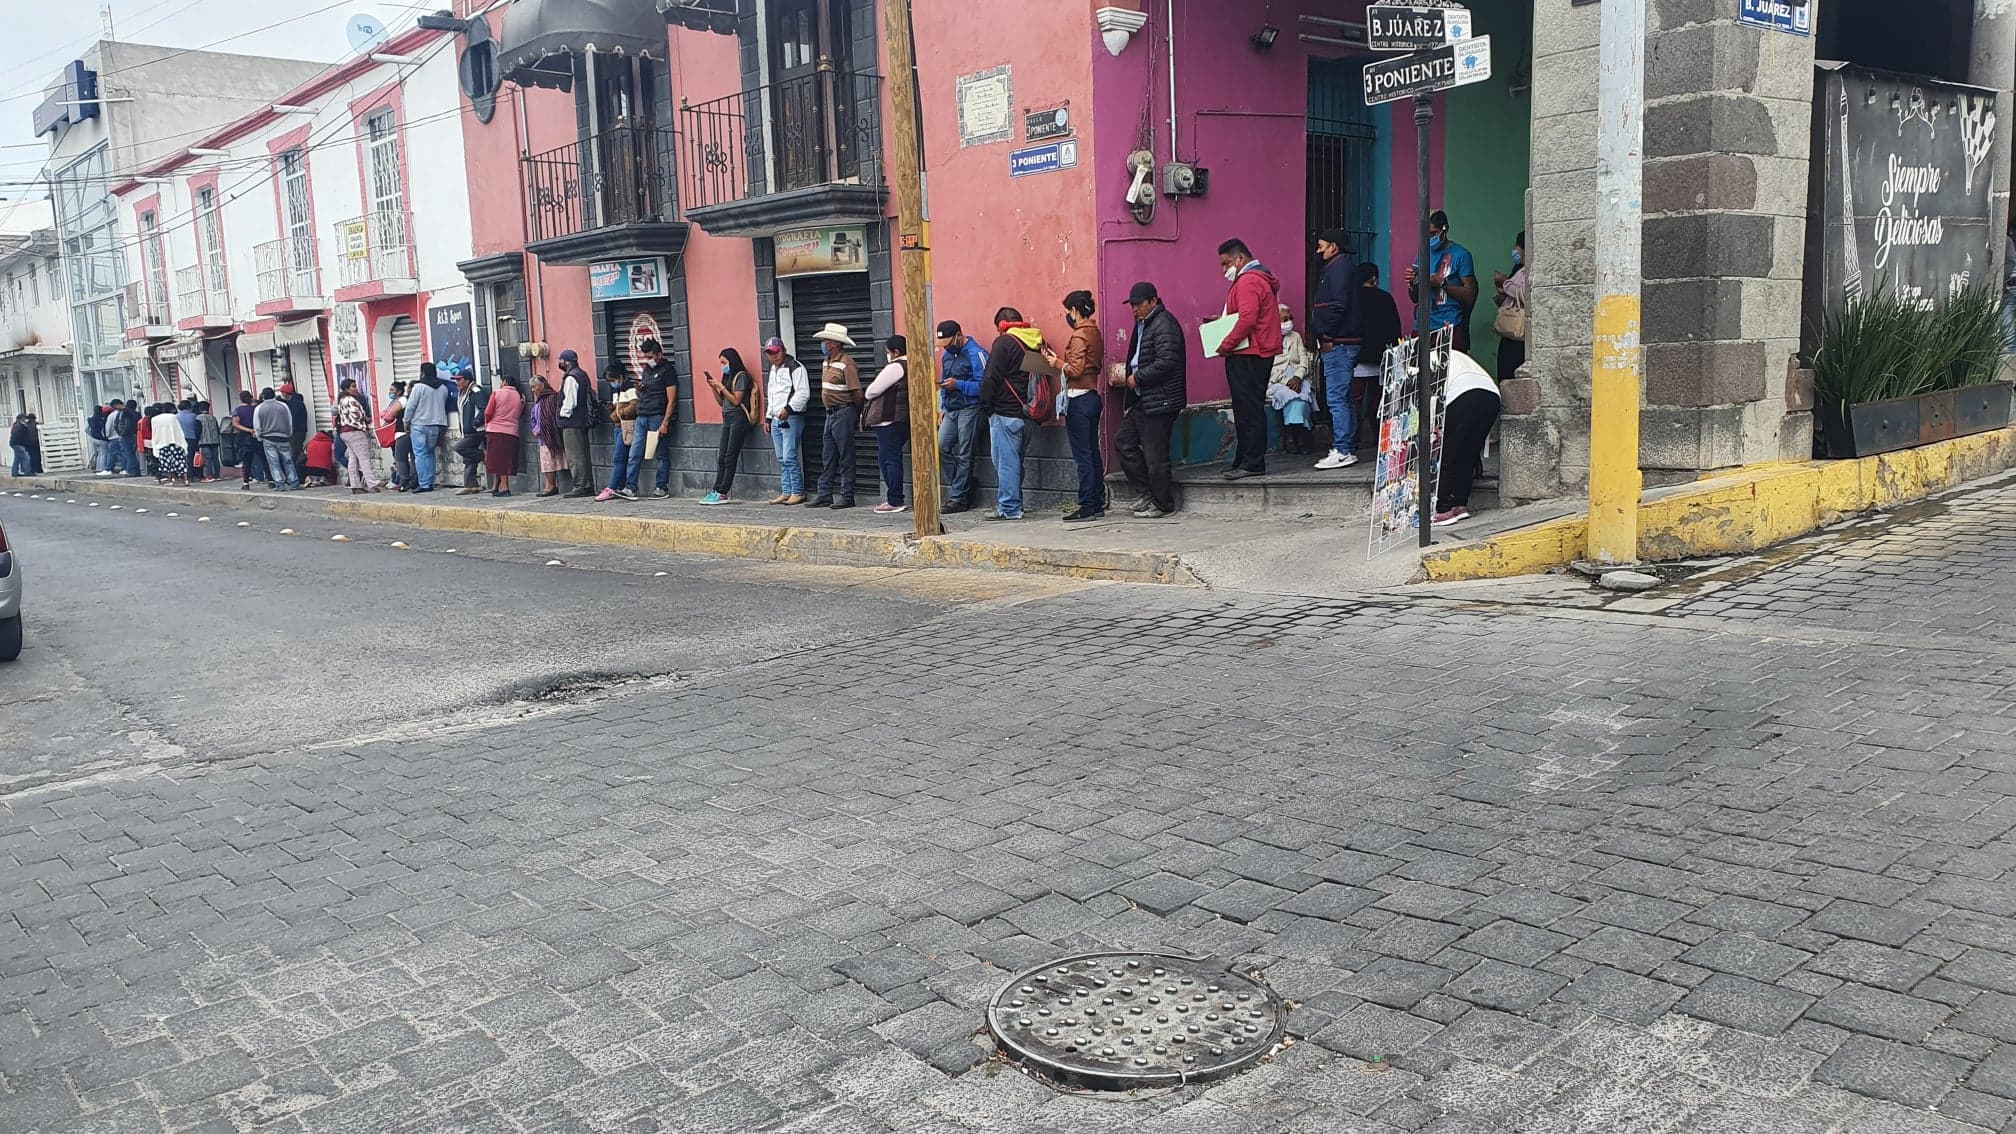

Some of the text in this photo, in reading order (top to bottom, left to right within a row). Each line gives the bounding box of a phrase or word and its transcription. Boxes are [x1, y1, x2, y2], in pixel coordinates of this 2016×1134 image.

[1375, 57, 1454, 91] PONIENTE
[1011, 159, 1017, 168] 3
[1018, 151, 1057, 167] PONIENTE
[1881, 153, 1941, 207] Siempre
[1874, 203, 1944, 270] Deliciosas
